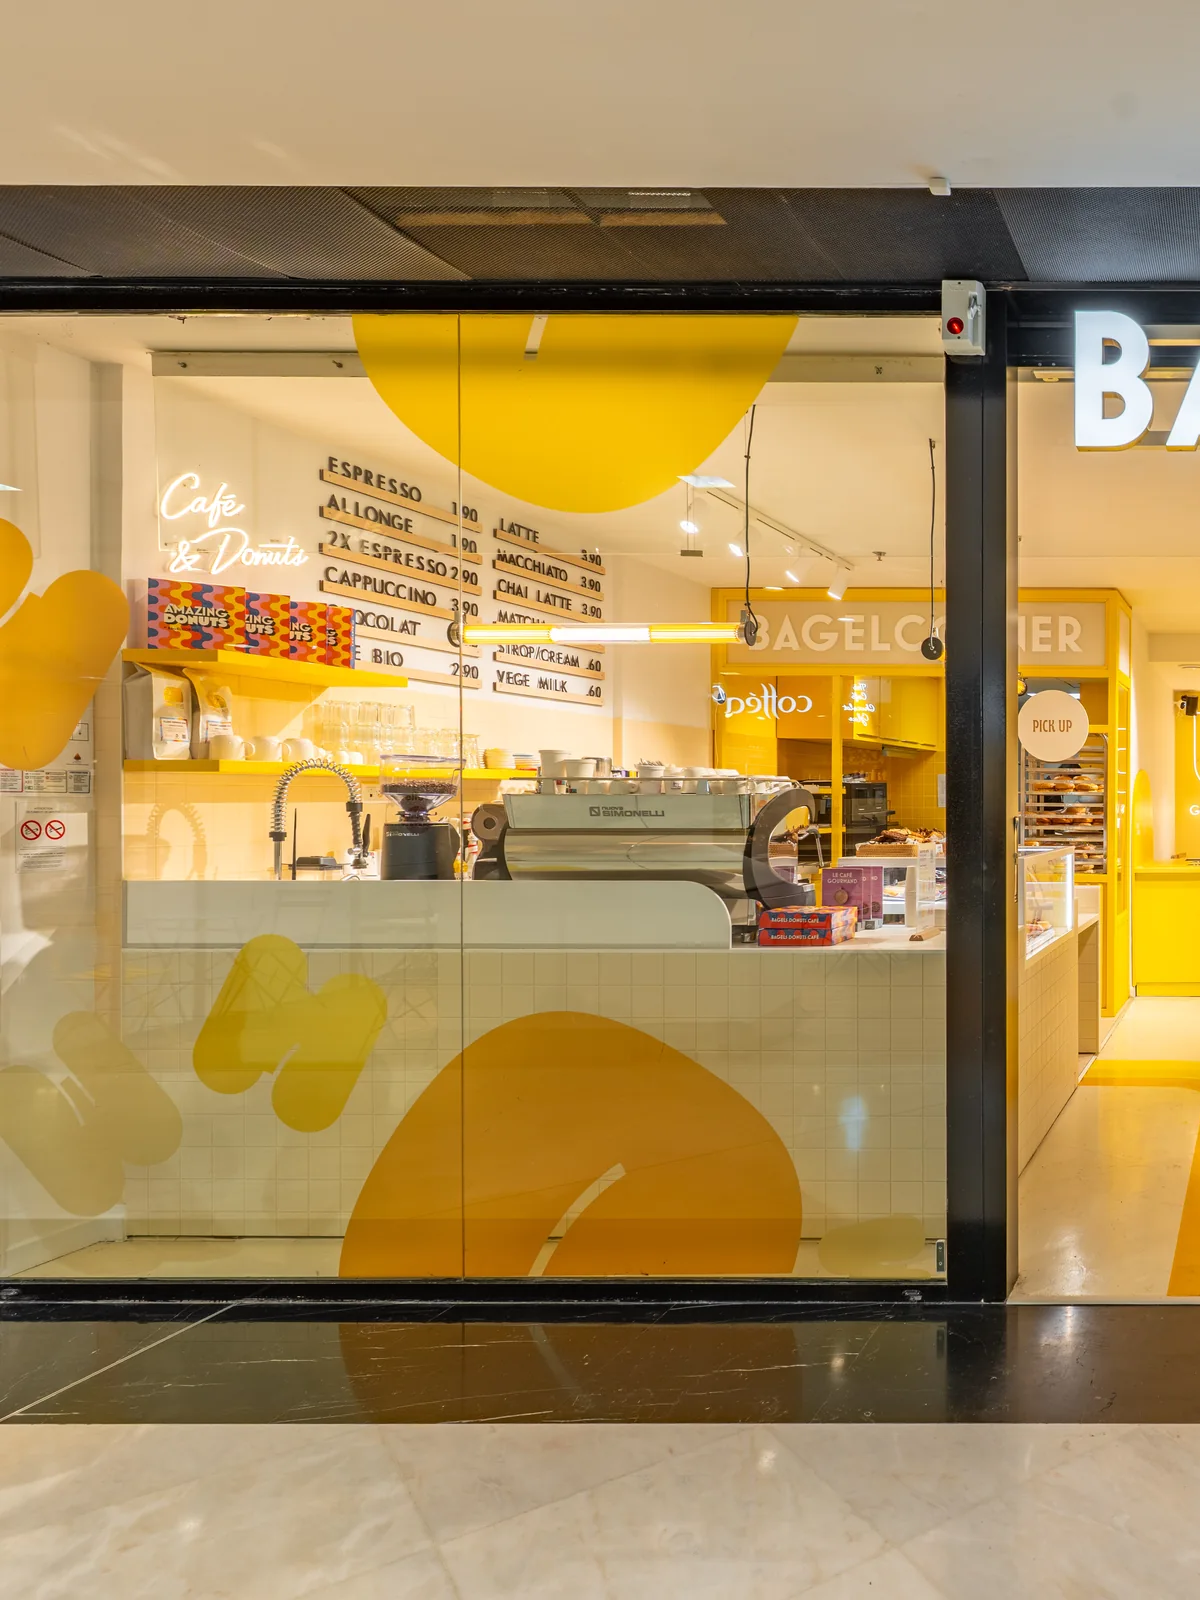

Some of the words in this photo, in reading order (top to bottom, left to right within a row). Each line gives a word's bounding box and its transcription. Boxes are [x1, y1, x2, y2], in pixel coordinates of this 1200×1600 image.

[328, 456, 422, 502] ESPRESSO
[161, 473, 245, 528] Café
[327, 494, 413, 534] ALLONGE
[169, 540, 207, 574] &
[190, 527, 309, 575] Donuts
[500, 518, 539, 544] LATTE
[327, 530, 351, 551] 2X
[359, 539, 447, 577] ESPRESSO
[497, 548, 568, 582] MACCHIATO
[581, 576, 601, 593] 3.90
[324, 566, 437, 607] CAPPUCCINO
[497, 579, 528, 599] CHAI
[536, 590, 572, 611] LATTE
[581, 603, 602, 619] 3.90
[163, 614, 230, 630] DONUTS
[164, 603, 230, 619] AMAZING
[371, 648, 404, 667] BIO
[496, 670, 530, 688] VEGE
[537, 676, 568, 693] MILK
[1032, 719, 1054, 733] PICK
[1058, 719, 1073, 733] UP
